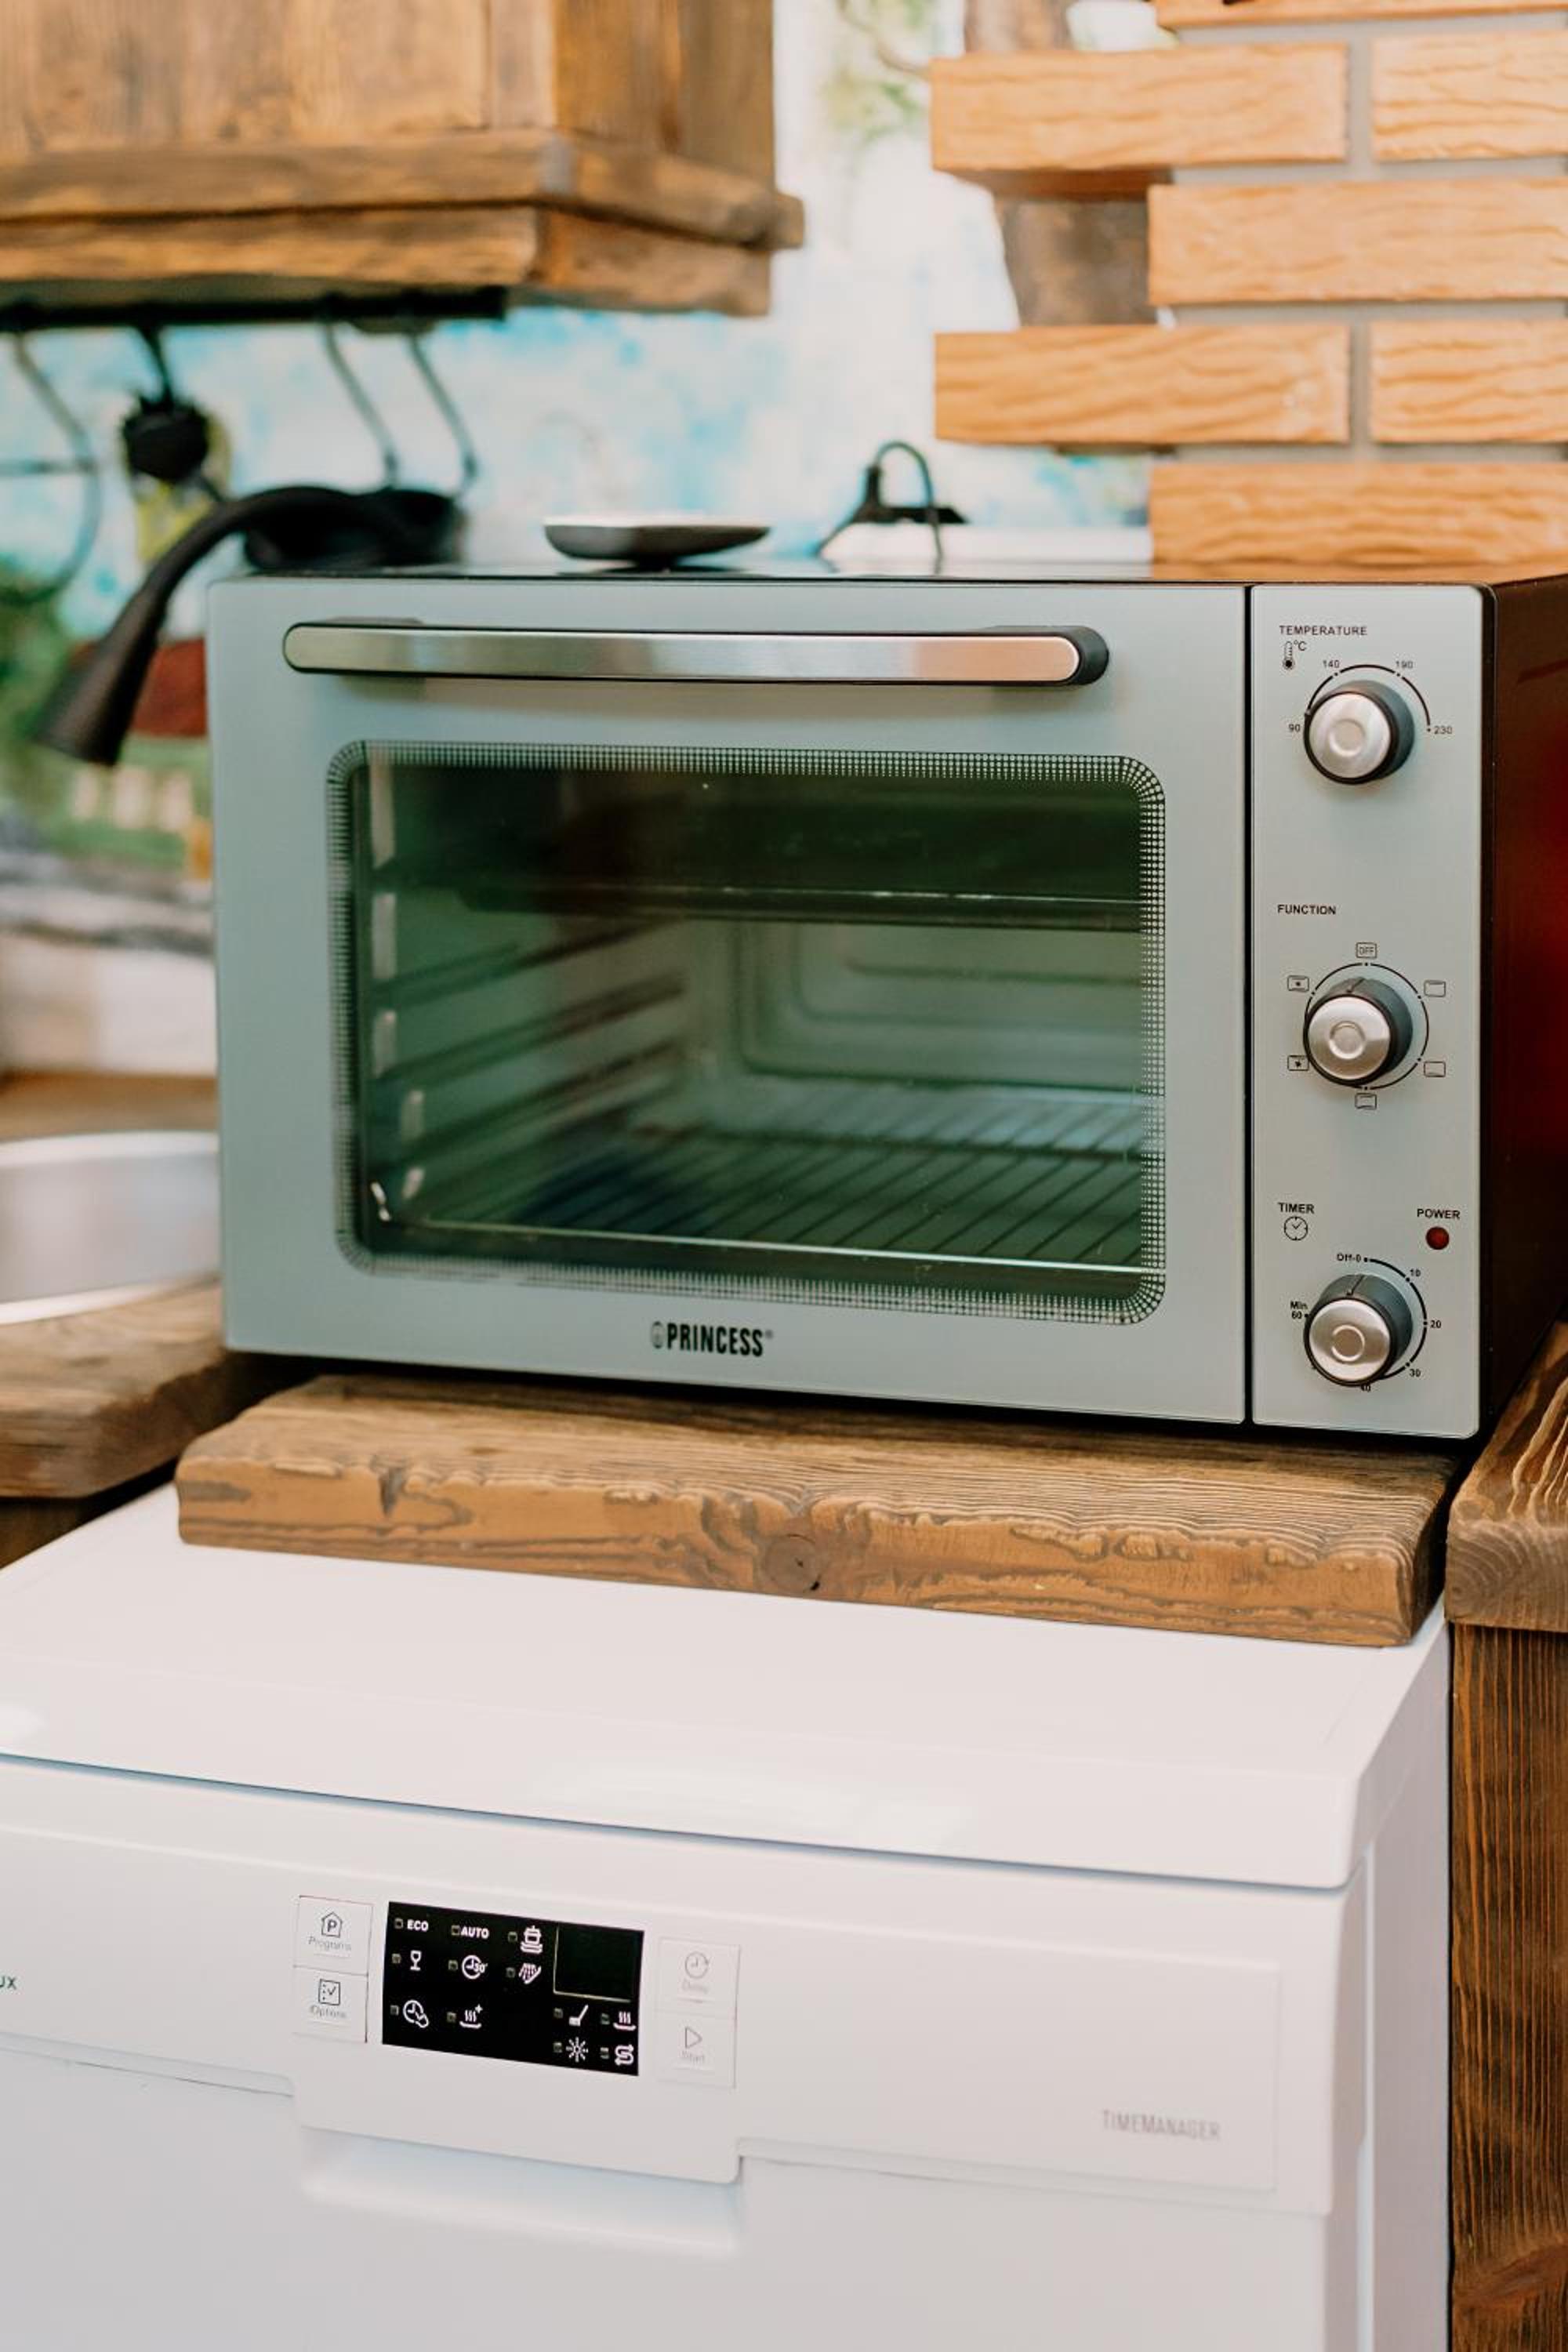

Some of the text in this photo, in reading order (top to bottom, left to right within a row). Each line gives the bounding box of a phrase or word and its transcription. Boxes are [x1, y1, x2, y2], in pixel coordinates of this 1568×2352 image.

[1279, 625, 1368, 636] TEMPERATURE
[1323, 659, 1340, 669] 140
[1396, 660, 1414, 670] 190
[1288, 724, 1301, 733] 90
[1434, 725, 1453, 735] 230
[1277, 904, 1337, 915] FUNCTION
[1359, 946, 1374, 956] OFF
[1278, 1203, 1315, 1214] TIMER
[1417, 1208, 1461, 1220] POWER
[1410, 1269, 1421, 1277] 10
[1290, 1301, 1308, 1310] Min
[1291, 1311, 1302, 1319] 60
[1430, 1319, 1442, 1329] 20
[1410, 1368, 1421, 1377] 30
[407, 1918, 429, 1932] ECO
[460, 1926, 489, 1939] AUTO
[1102, 2109, 1221, 2142] TIMEMANAGER
